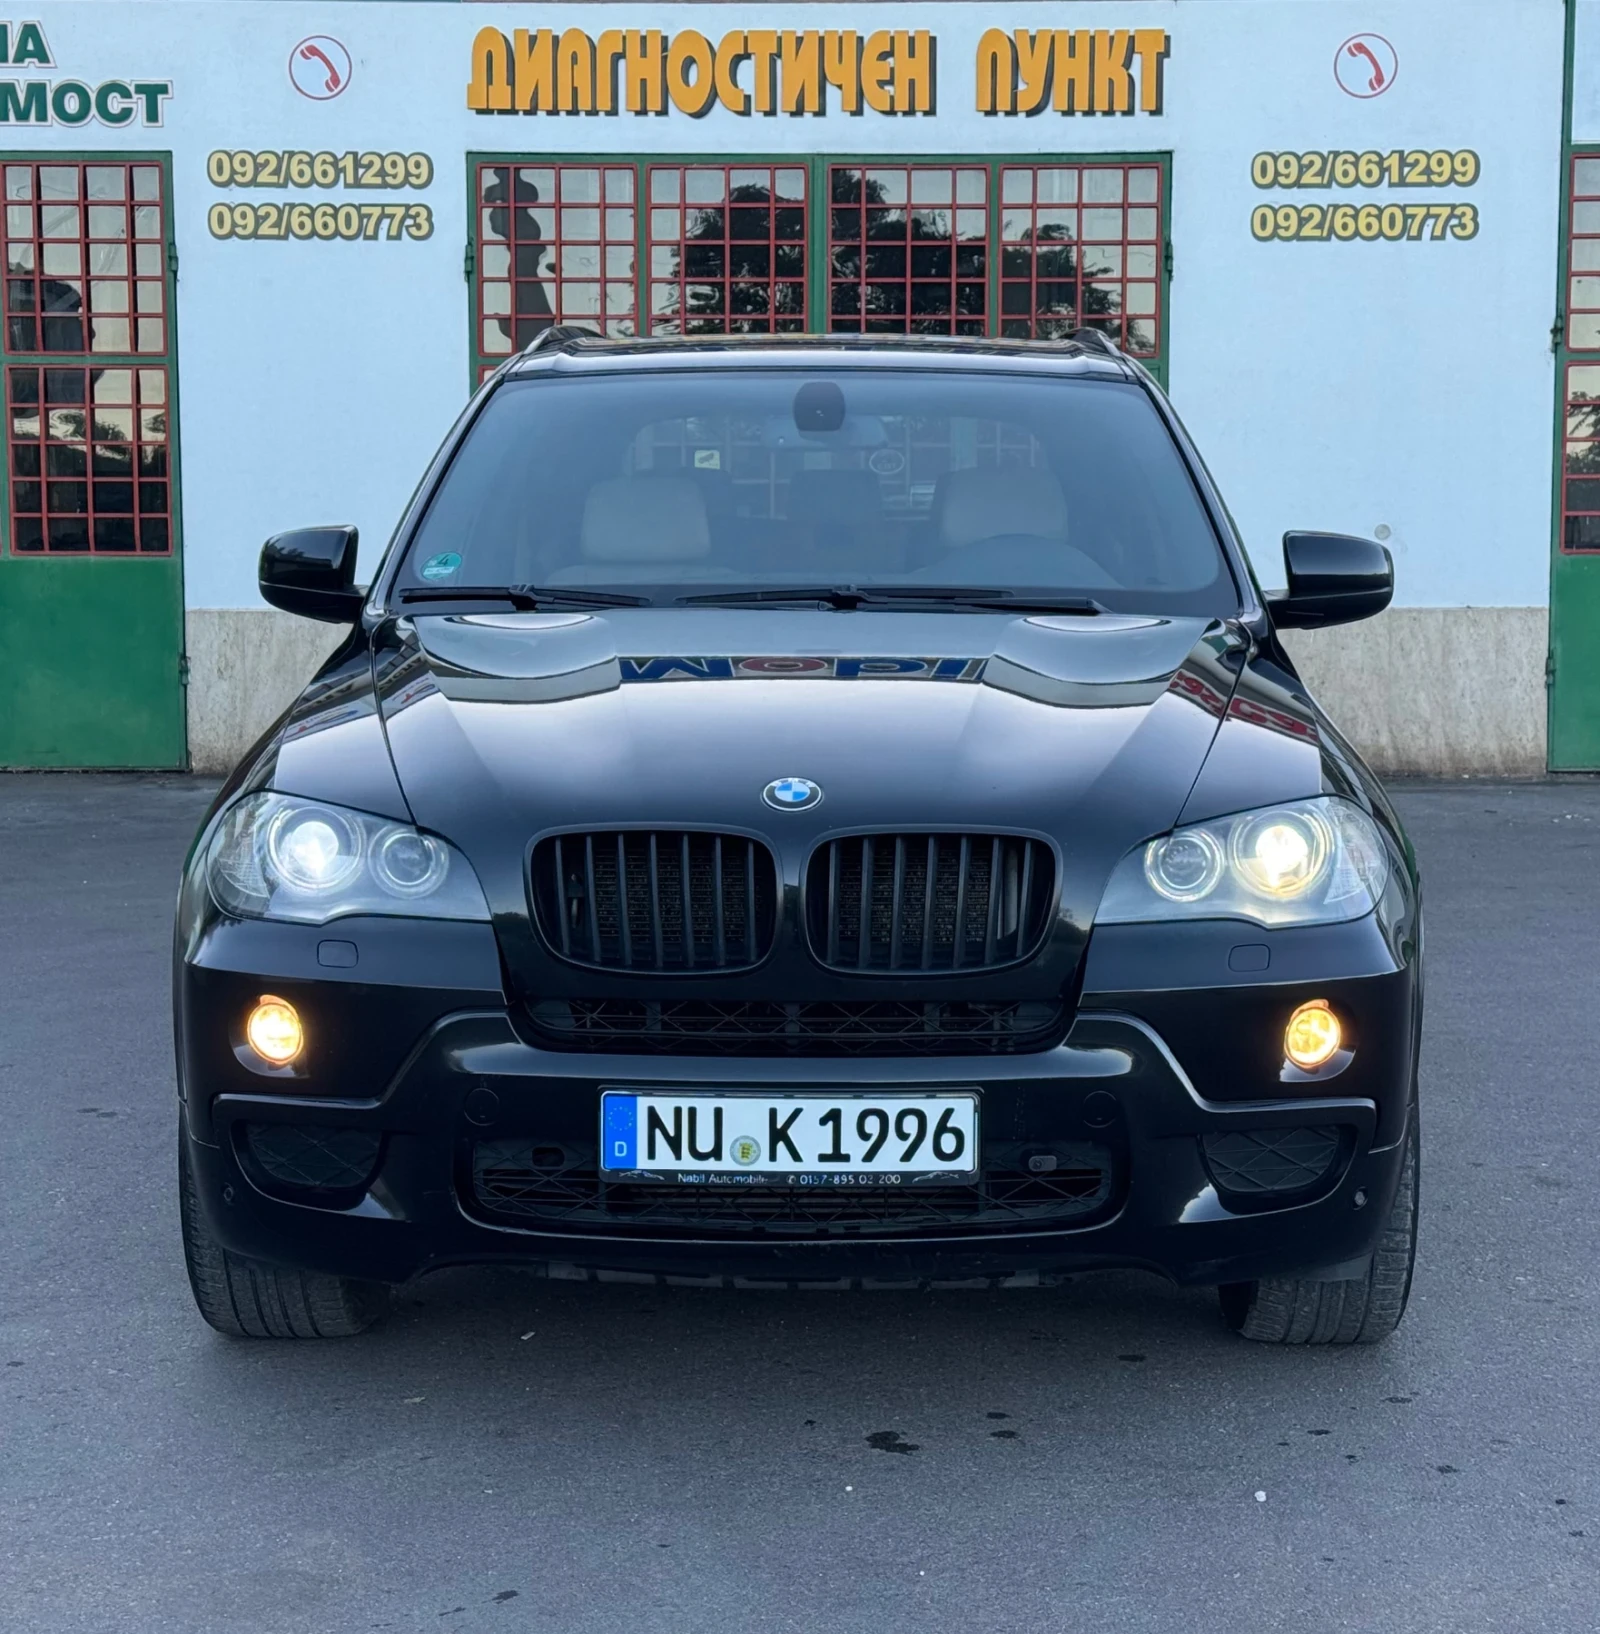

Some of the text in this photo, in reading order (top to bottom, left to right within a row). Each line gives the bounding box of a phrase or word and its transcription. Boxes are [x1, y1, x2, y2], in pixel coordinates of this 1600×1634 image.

[0, 22, 56, 67] А
[467, 26, 1170, 116] ДИАГНОСТИЧЕН ПУНКТ
[207, 151, 433, 189] 092/661299
[1252, 150, 1479, 188] 092/661299
[208, 203, 433, 241] 092/660773
[1252, 204, 1478, 241] 092/660773
[437, 553, 449, 566] 4
[614, 1141, 628, 1157] D
[647, 1105, 965, 1163] NU K 1996
[878, 1174, 901, 1185] 200
